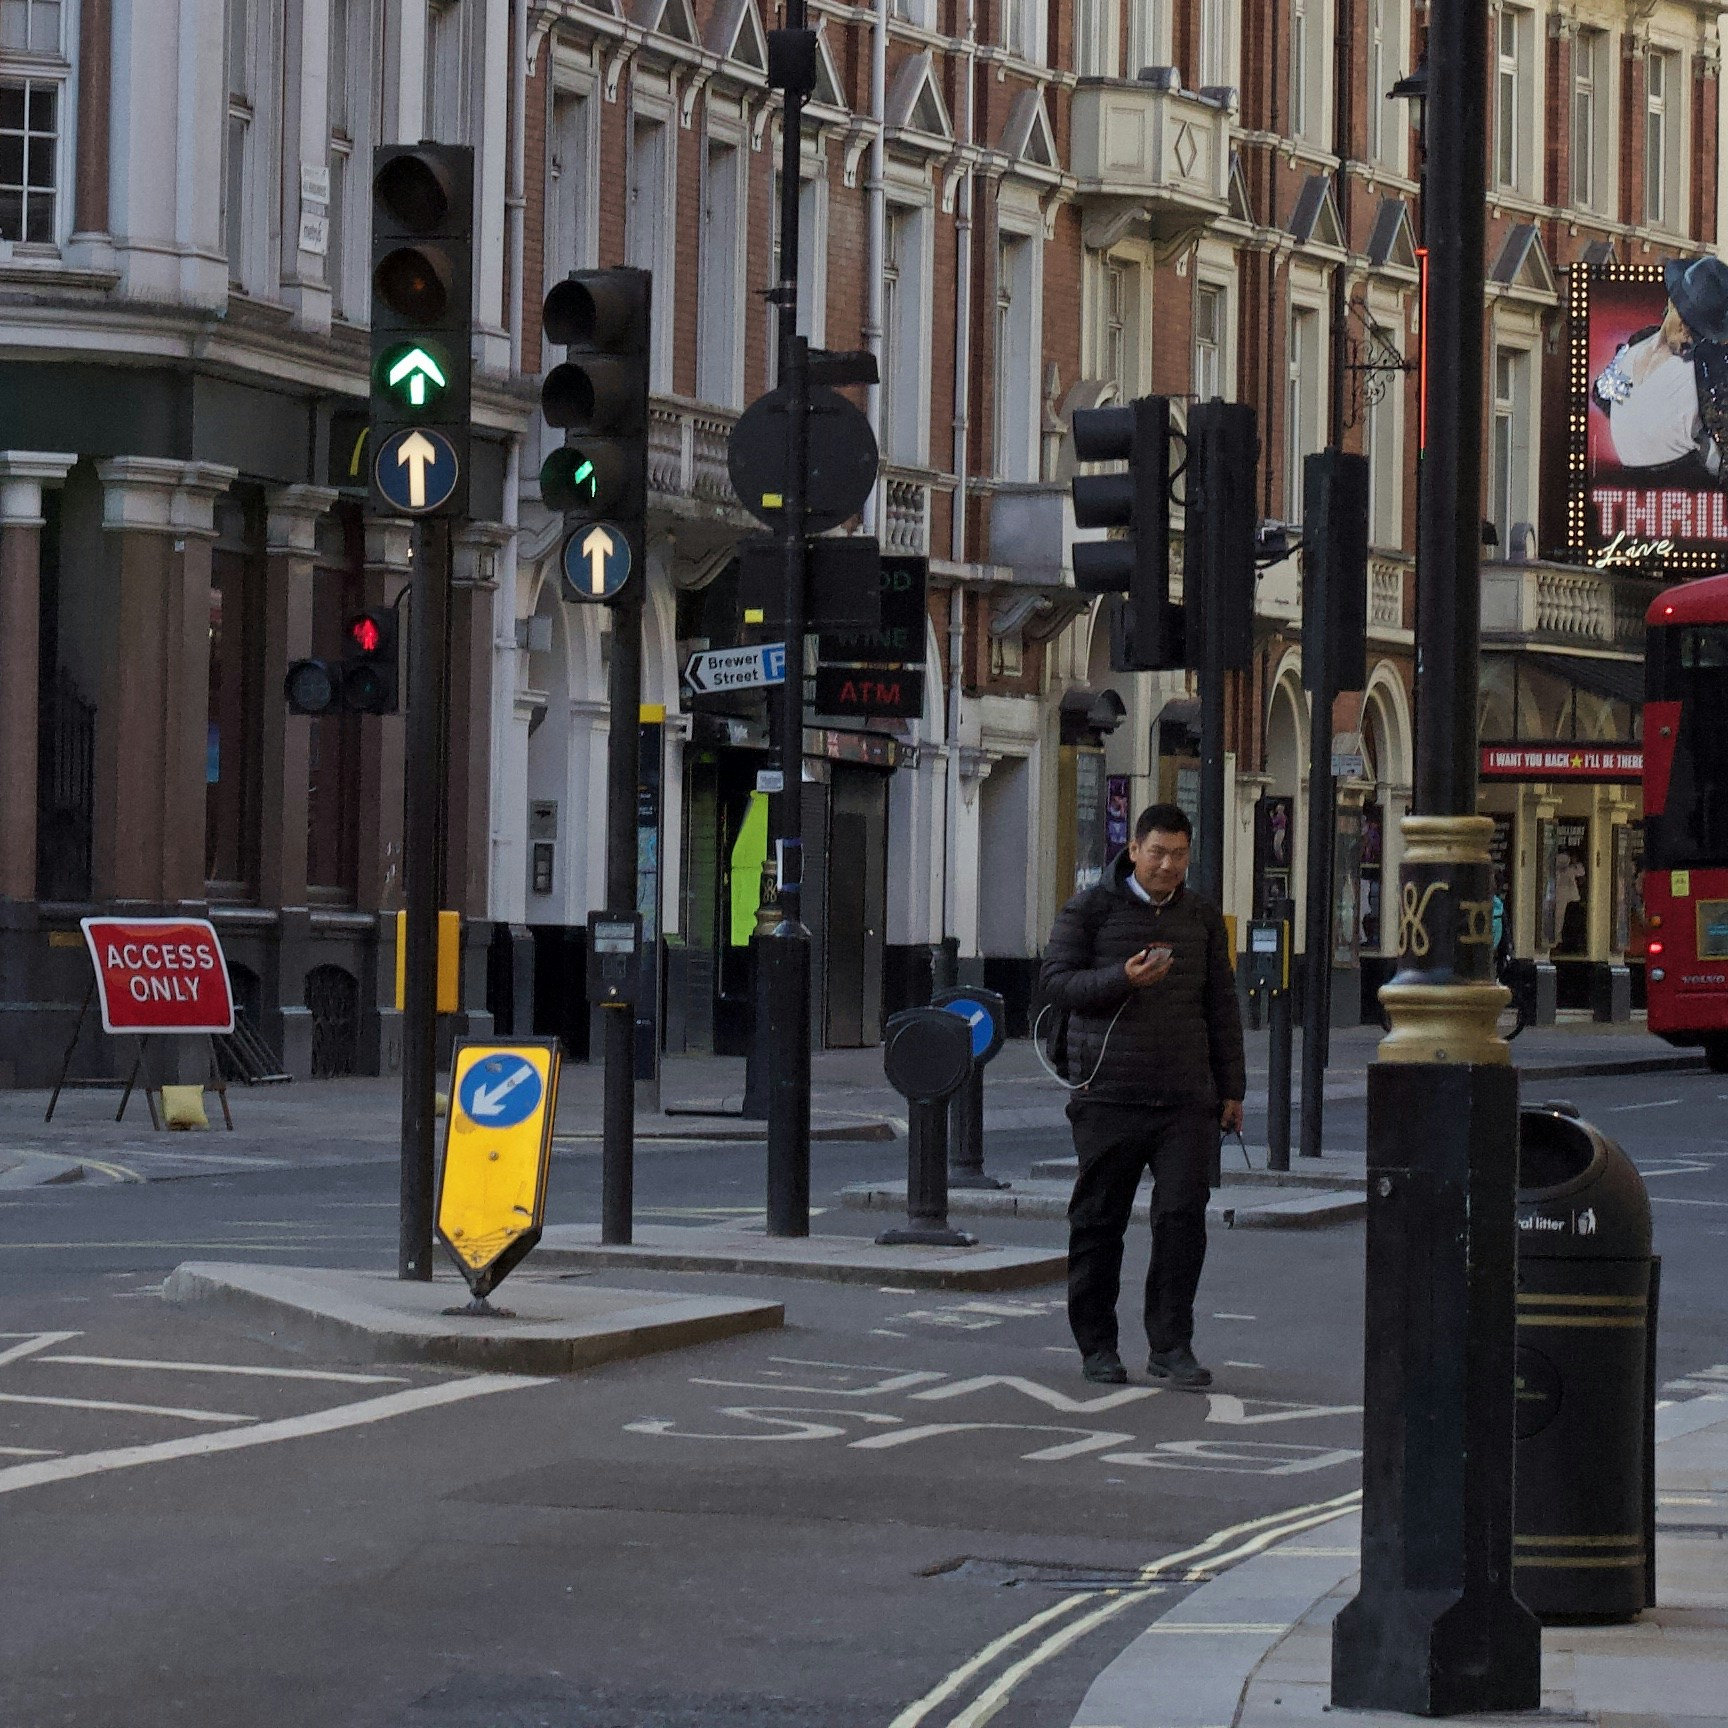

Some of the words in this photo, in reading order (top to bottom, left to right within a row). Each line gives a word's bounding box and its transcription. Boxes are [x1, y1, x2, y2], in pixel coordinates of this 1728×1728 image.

[1595, 530, 1674, 569] Live
[708, 654, 759, 669] Brewer
[713, 668, 759, 685] Street
[839, 680, 902, 705] ATM
[1496, 753, 1522, 767] WANT
[1525, 753, 1543, 767] YOU
[1545, 753, 1570, 768] BACK
[1584, 754, 1599, 768] I'LL
[1602, 755, 1614, 768] BE
[1617, 754, 1644, 769] THERE
[106, 943, 214, 970] ACCESS
[129, 975, 200, 1002] ONLY
[1535, 1216, 1565, 1231] litter
